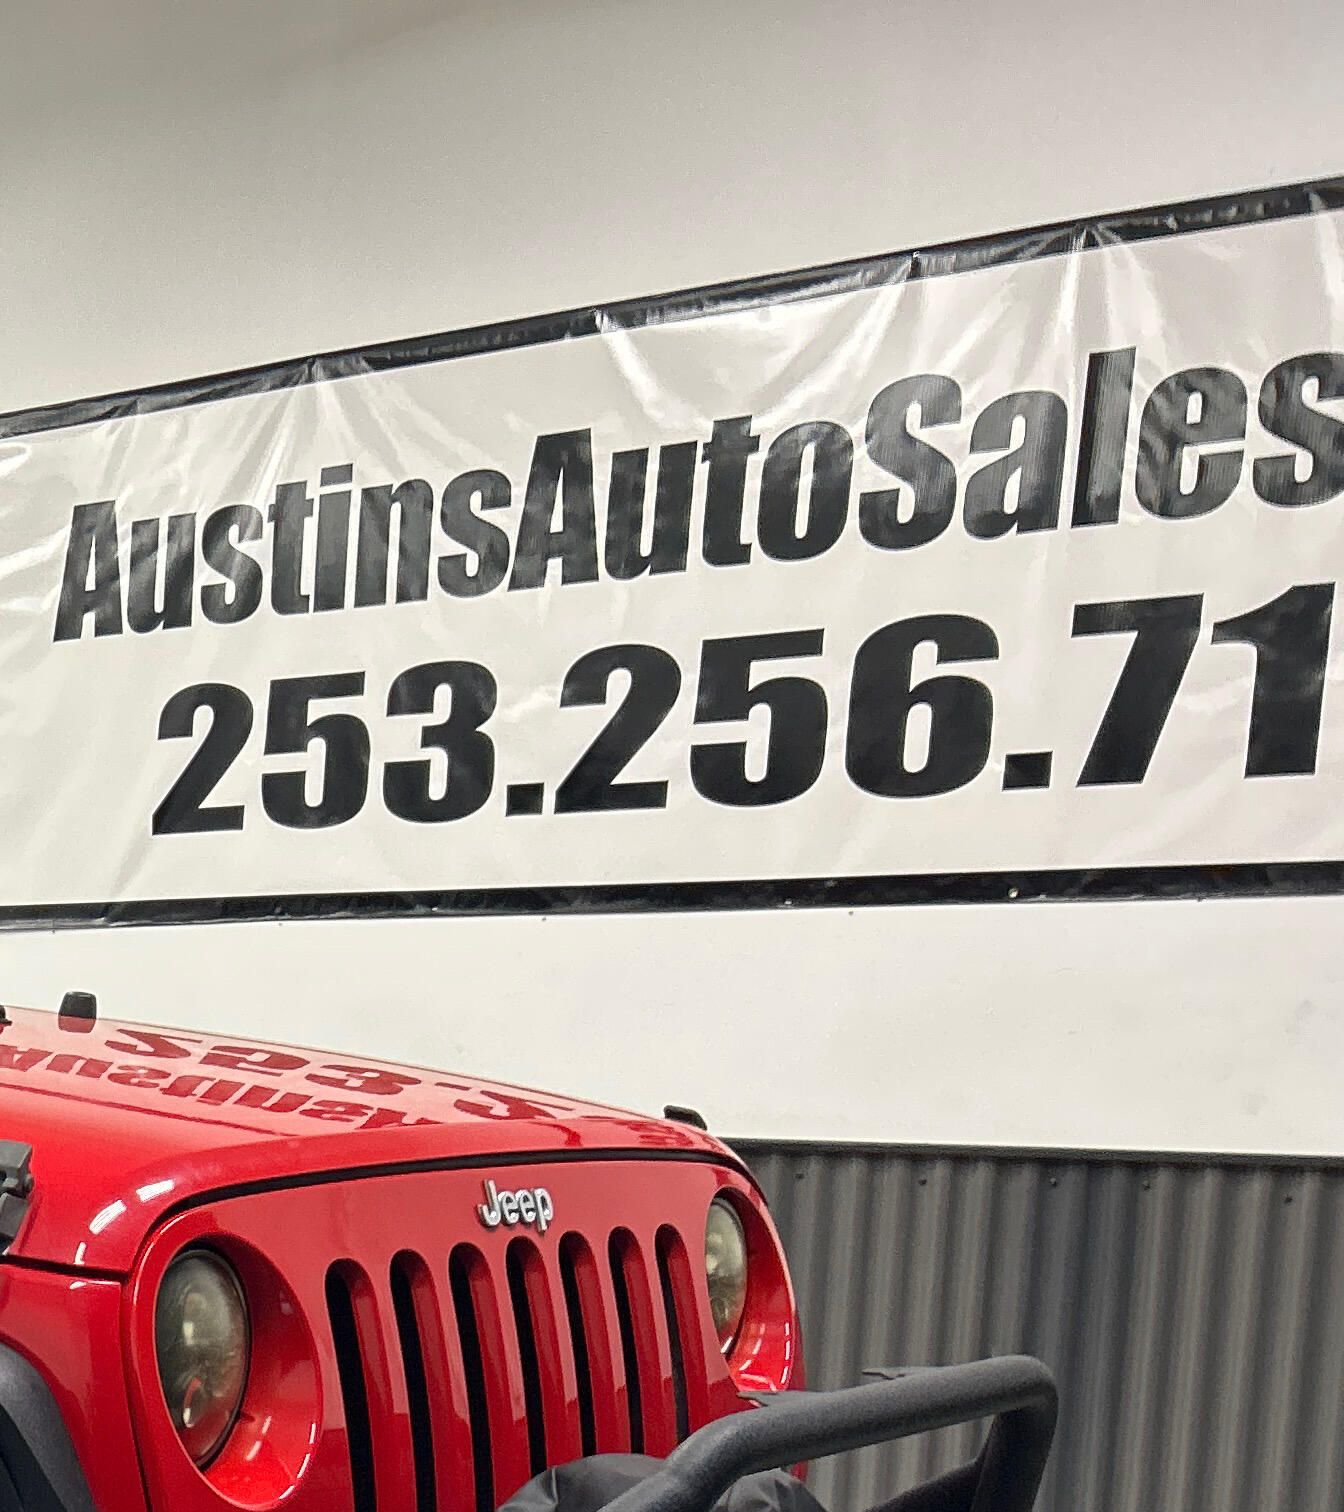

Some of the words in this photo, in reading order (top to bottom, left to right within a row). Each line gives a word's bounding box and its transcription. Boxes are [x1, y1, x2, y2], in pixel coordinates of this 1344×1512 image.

[53, 346, 1344, 642] AustinsAutoSales
[151, 582, 1336, 836] 253.256.71
[477, 1179, 554, 1233] Jeep
